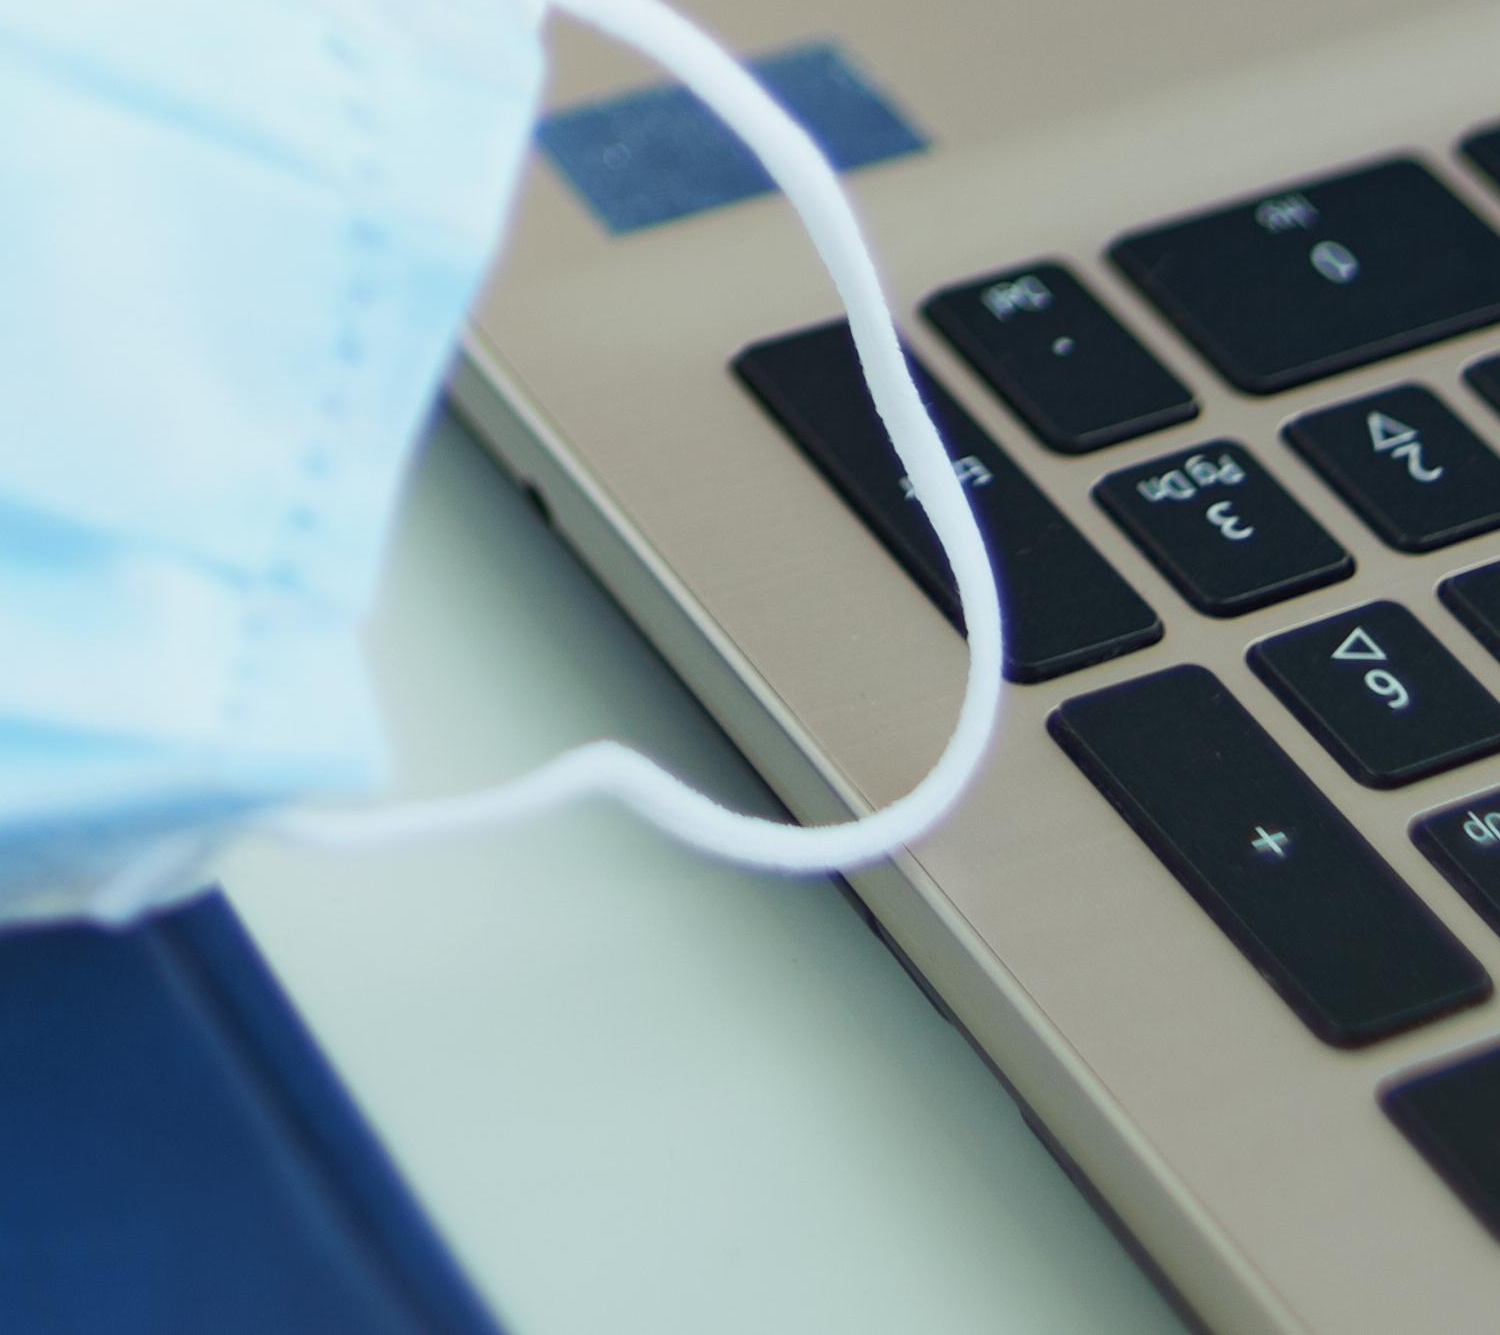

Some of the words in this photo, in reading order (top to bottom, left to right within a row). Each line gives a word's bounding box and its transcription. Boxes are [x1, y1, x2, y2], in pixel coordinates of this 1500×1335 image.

[1311, 240, 1358, 283] 0
[1185, 455, 1245, 488] Pg
[1392, 442, 1443, 481] 2
[1137, 472, 1194, 502] Dn
[1207, 500, 1253, 540] 3
[1364, 668, 1408, 709] 6
[1251, 825, 1290, 858] +
